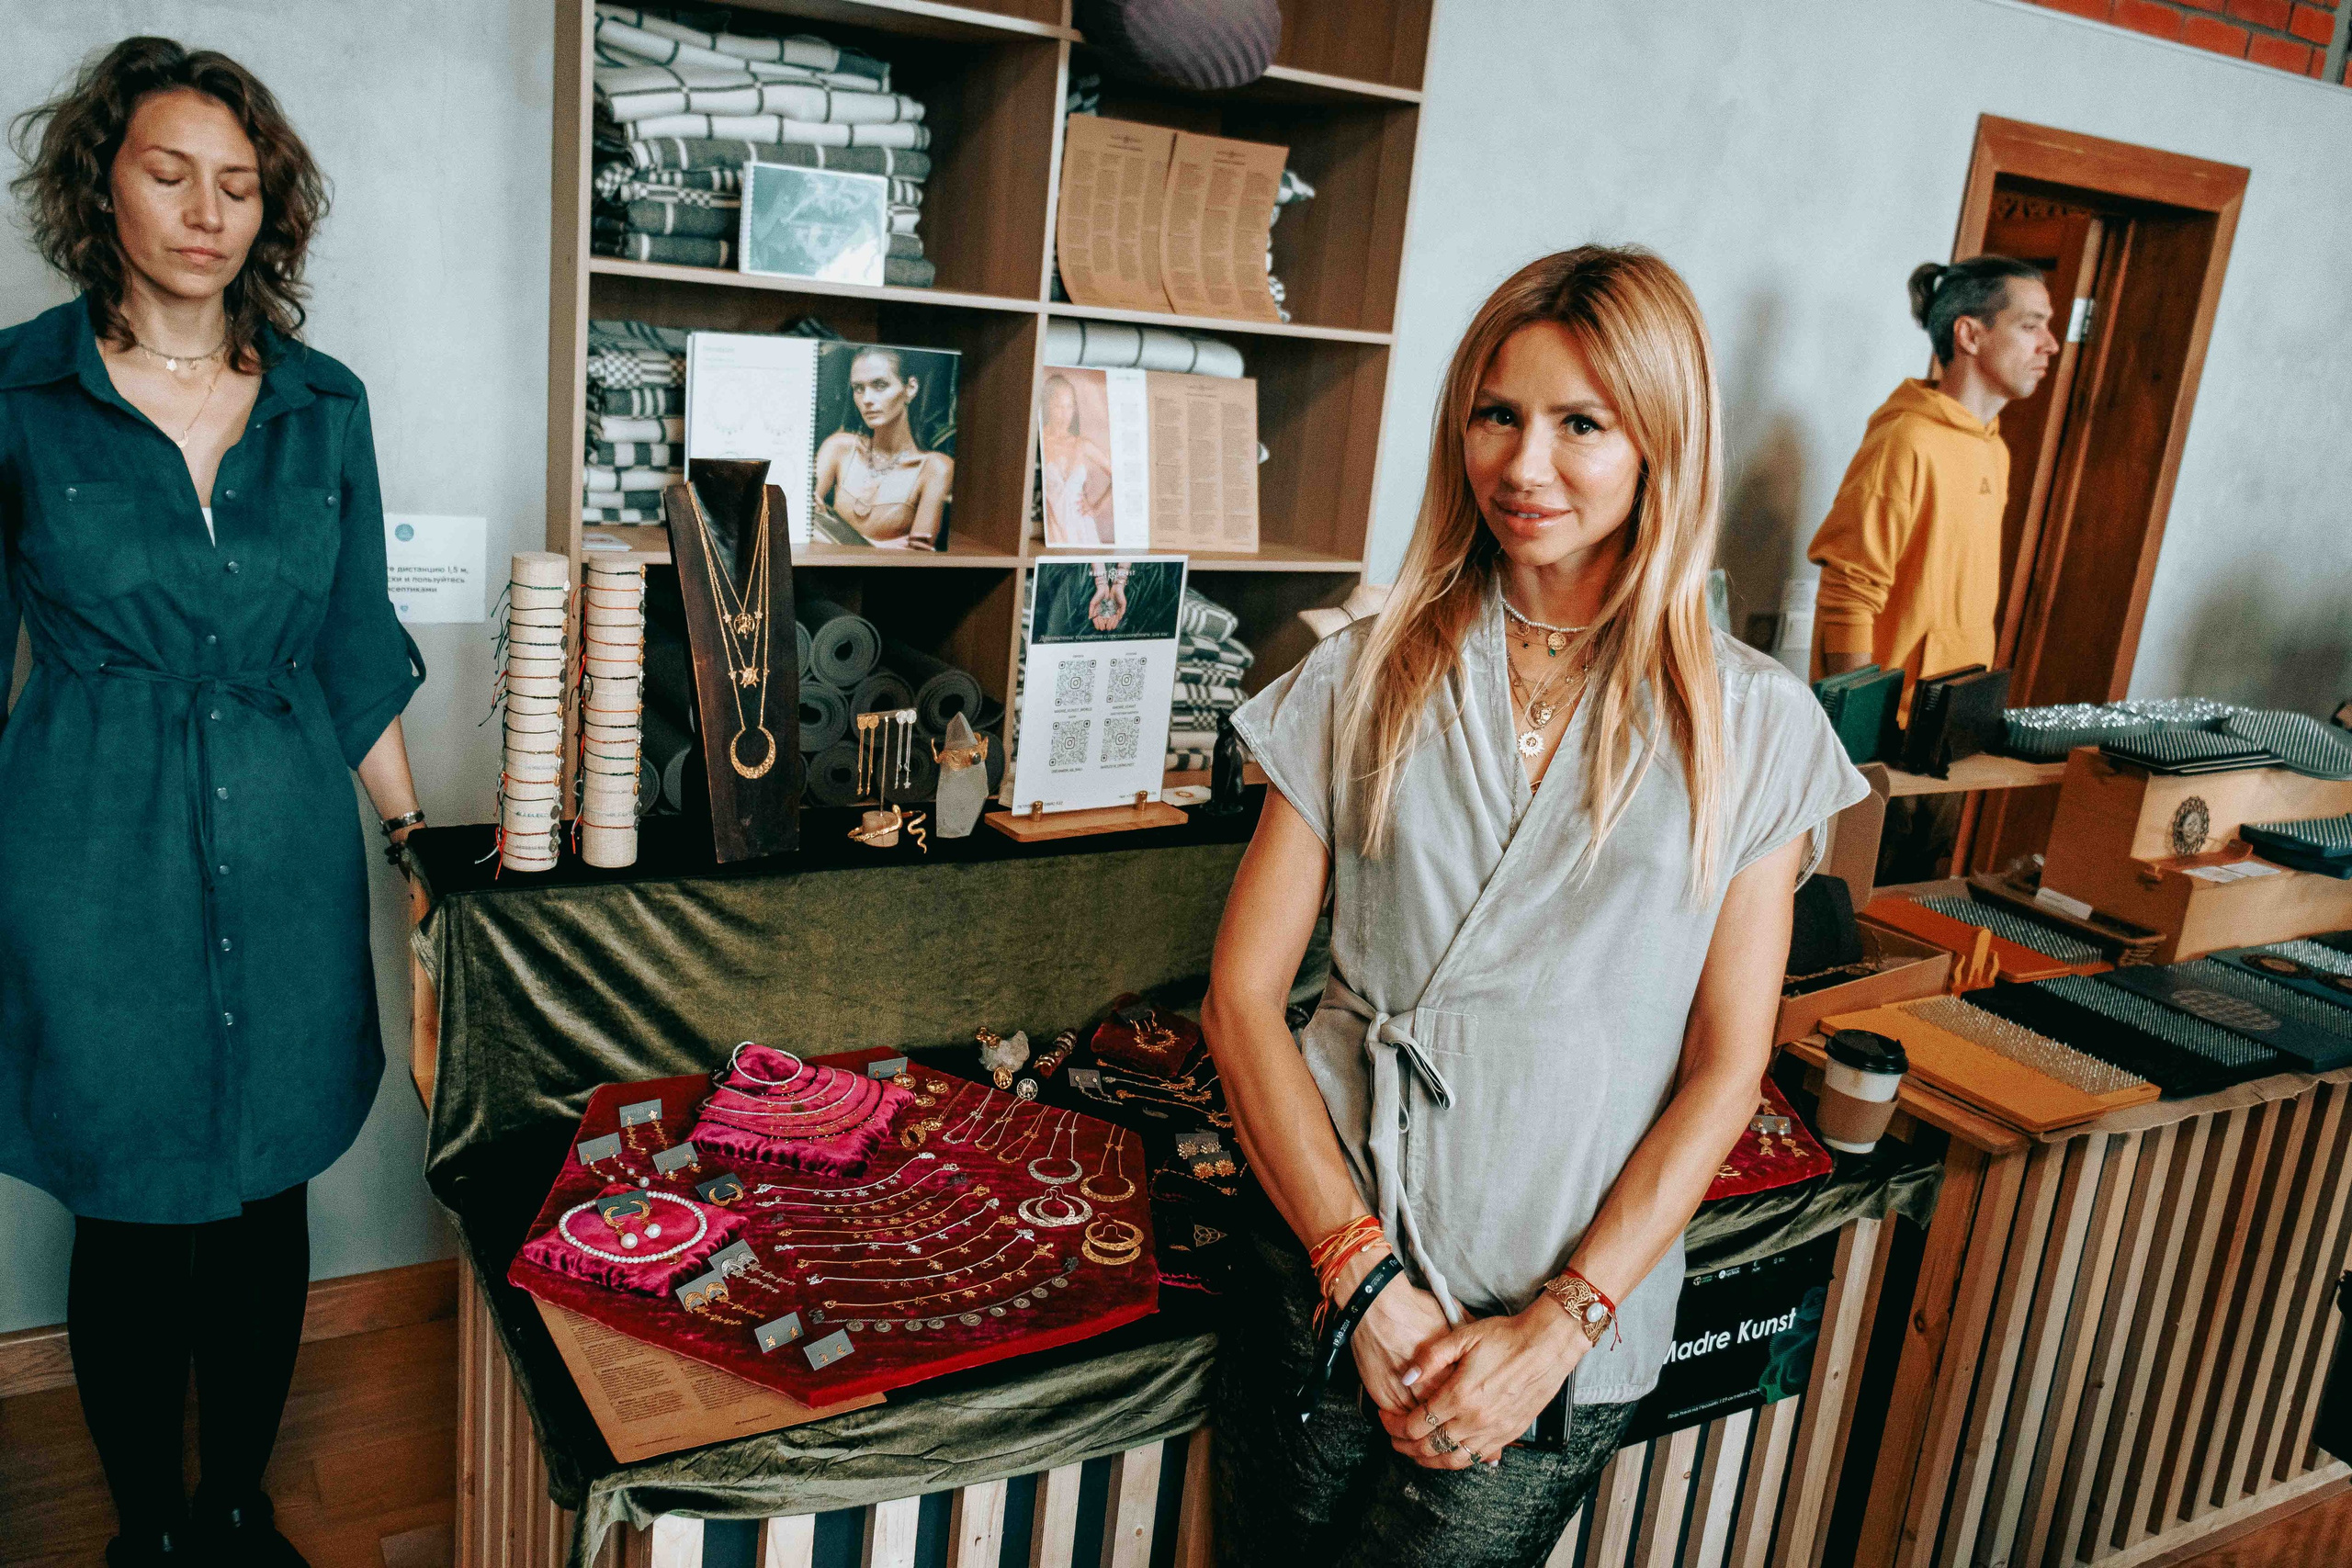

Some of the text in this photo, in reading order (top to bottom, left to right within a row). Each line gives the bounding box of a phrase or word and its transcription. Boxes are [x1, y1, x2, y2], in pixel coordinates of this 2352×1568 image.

[397, 566, 446, 574] дистанцию
[1332, 1319, 1351, 1346] 19.10.2024
[1736, 1307, 1797, 1344] Kunst
